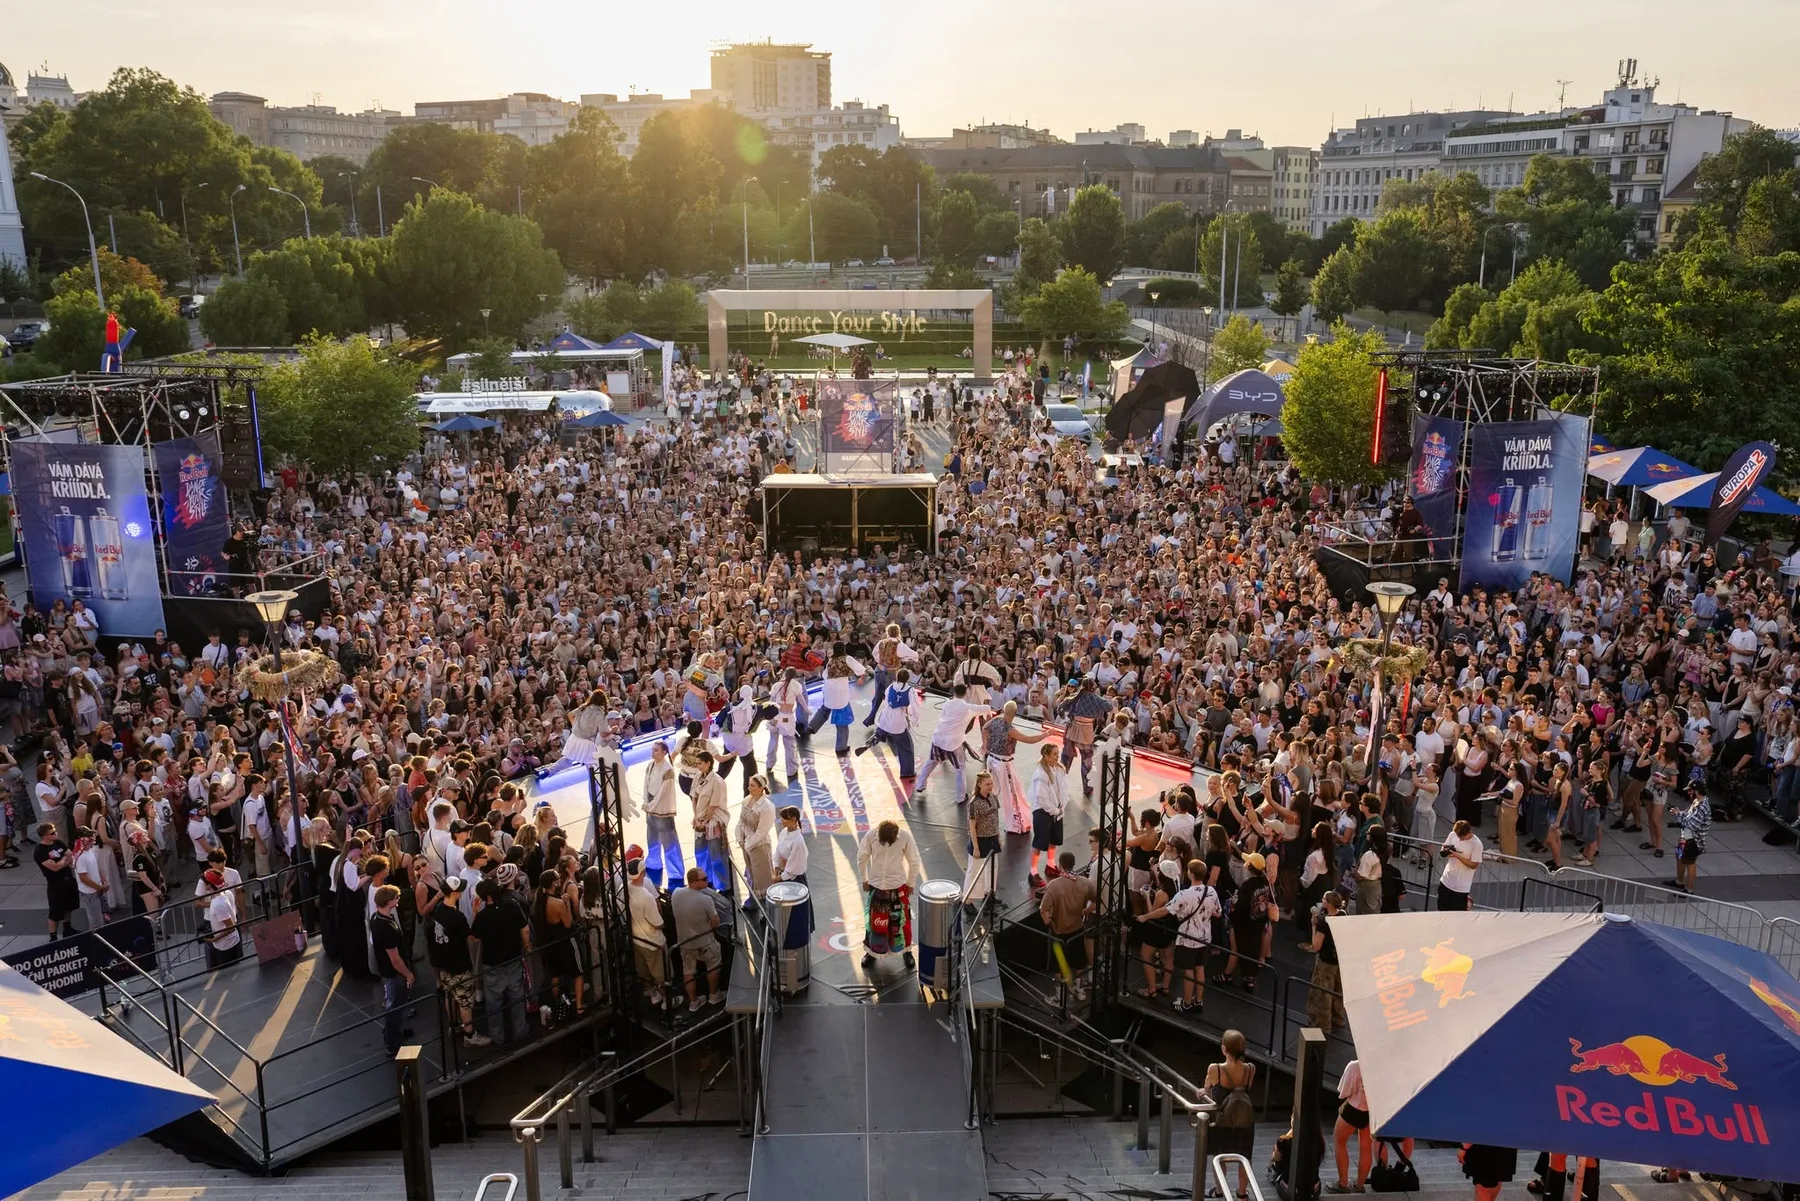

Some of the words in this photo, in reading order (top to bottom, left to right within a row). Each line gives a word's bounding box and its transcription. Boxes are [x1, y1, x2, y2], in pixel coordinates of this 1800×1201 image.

[764, 311, 822, 333] Dance
[830, 311, 874, 333] Your
[881, 310, 928, 343] Style
[1229, 389, 1278, 402] BYD
[1504, 437, 1526, 452] VÁM
[1528, 436, 1552, 452] DÁVÁ
[48, 461, 74, 478] VÁM
[74, 462, 104, 479] DÁVÁ
[1502, 452, 1554, 471] KŘÍÍÍDLA.
[1720, 459, 1757, 500] EVROPA
[1752, 450, 1765, 464] 2
[51, 477, 111, 500] KŘÍÍÍDLA.
[33, 946, 80, 968] OVLÁDNE
[28, 970, 45, 982] ČNÍ
[46, 957, 88, 978] PARKET?
[1370, 949, 1415, 990] Red
[1378, 983, 1428, 1031] Bull
[1555, 1085, 1661, 1132] Red
[1664, 1096, 1770, 1146] Bull
